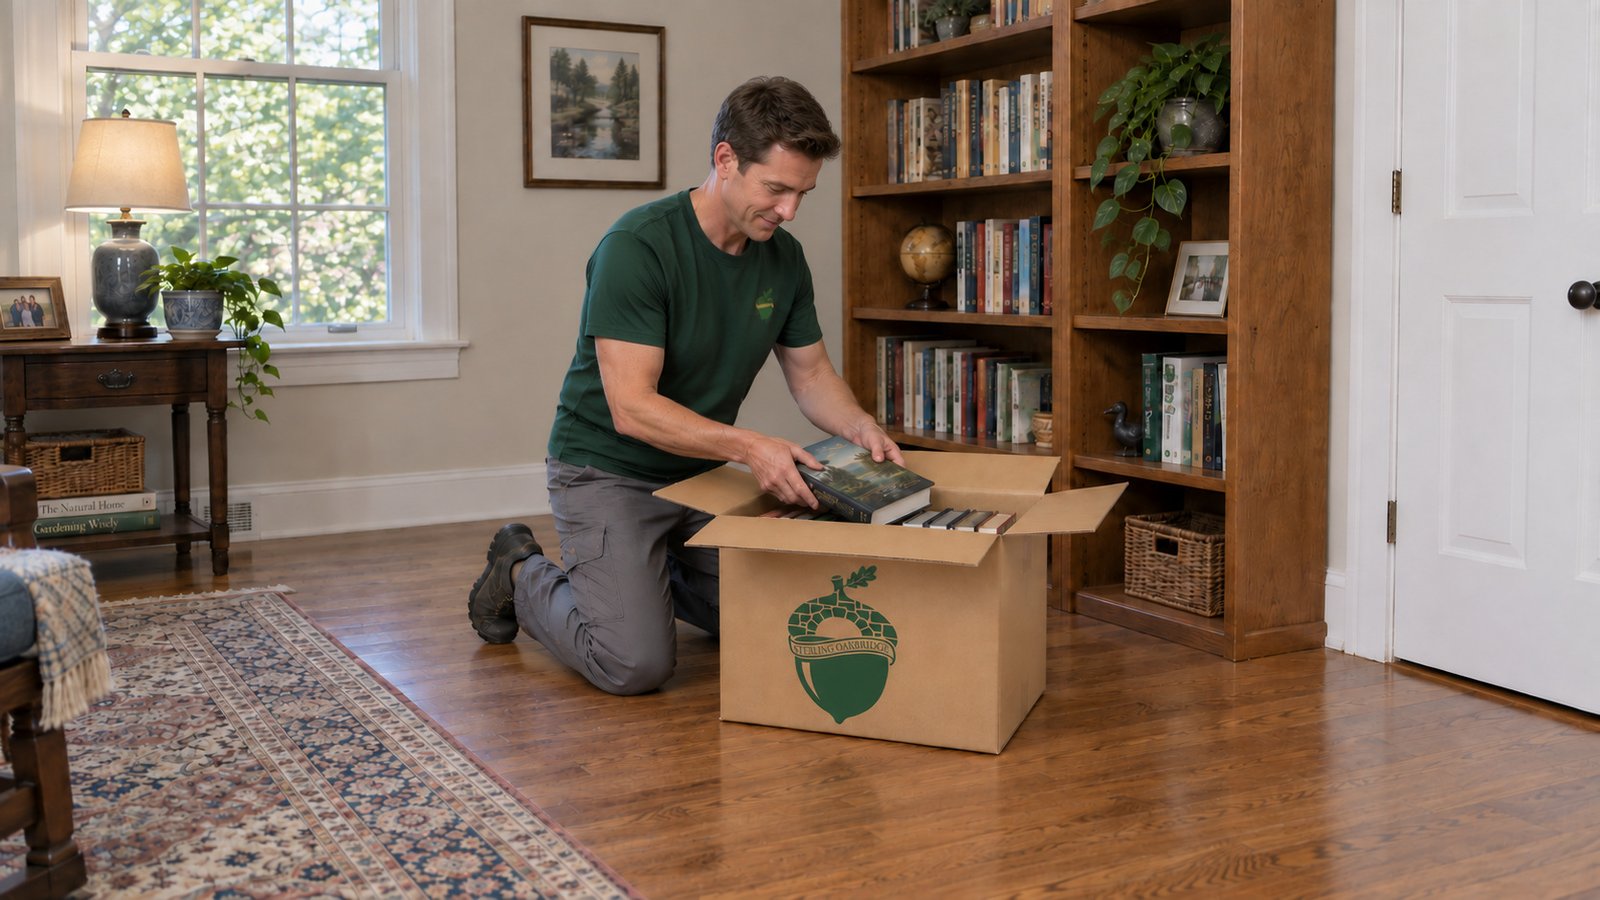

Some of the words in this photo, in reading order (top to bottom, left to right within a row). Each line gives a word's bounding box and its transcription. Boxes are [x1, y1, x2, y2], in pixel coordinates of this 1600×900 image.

[40, 504, 58, 514] The
[61, 501, 95, 512] Natural
[98, 500, 125, 510] Home
[33, 520, 86, 534] Gardening
[793, 643, 834, 655] STERLING
[835, 640, 890, 654] OAKBRIDGE
